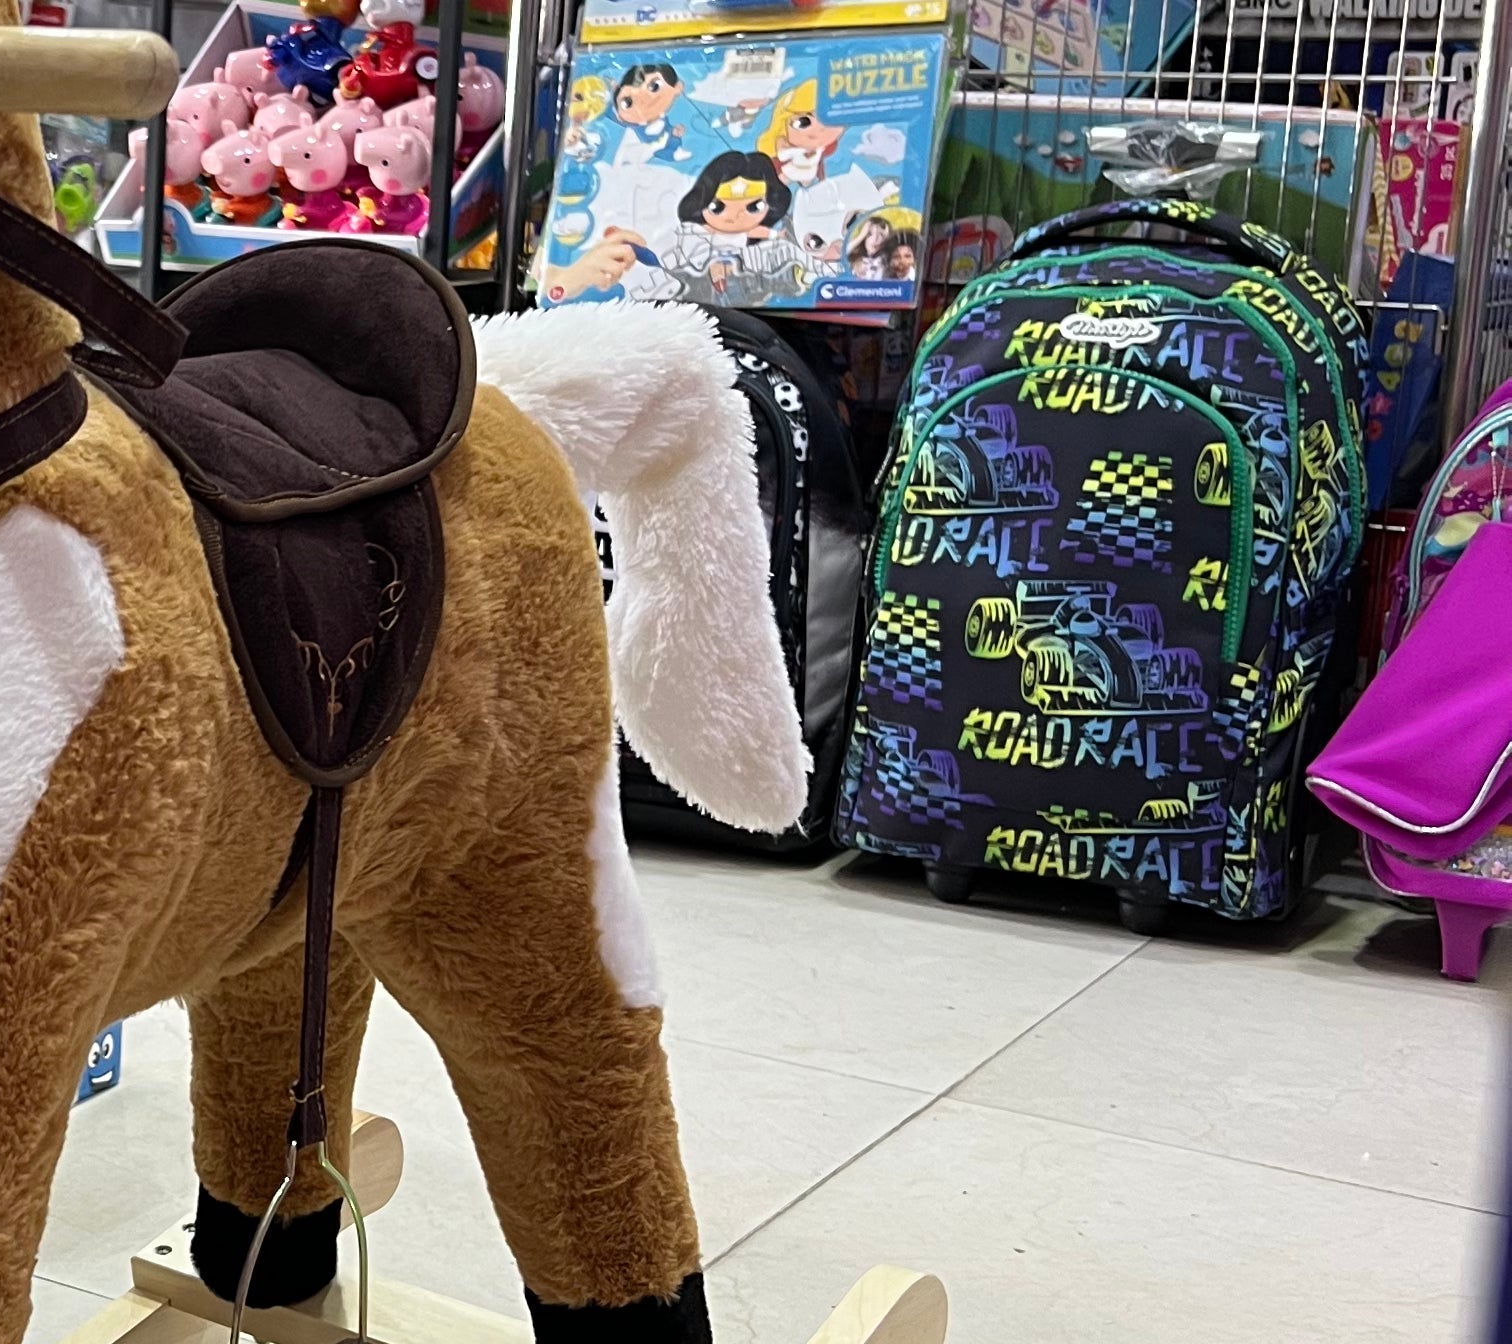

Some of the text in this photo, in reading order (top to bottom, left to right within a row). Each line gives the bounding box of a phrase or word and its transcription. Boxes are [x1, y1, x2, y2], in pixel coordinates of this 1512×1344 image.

[830, 63, 928, 98] PUZZLE
[836, 284, 902, 297] Clementoni
[958, 708, 1072, 769] ROAD
[984, 825, 1095, 878] ROAD
